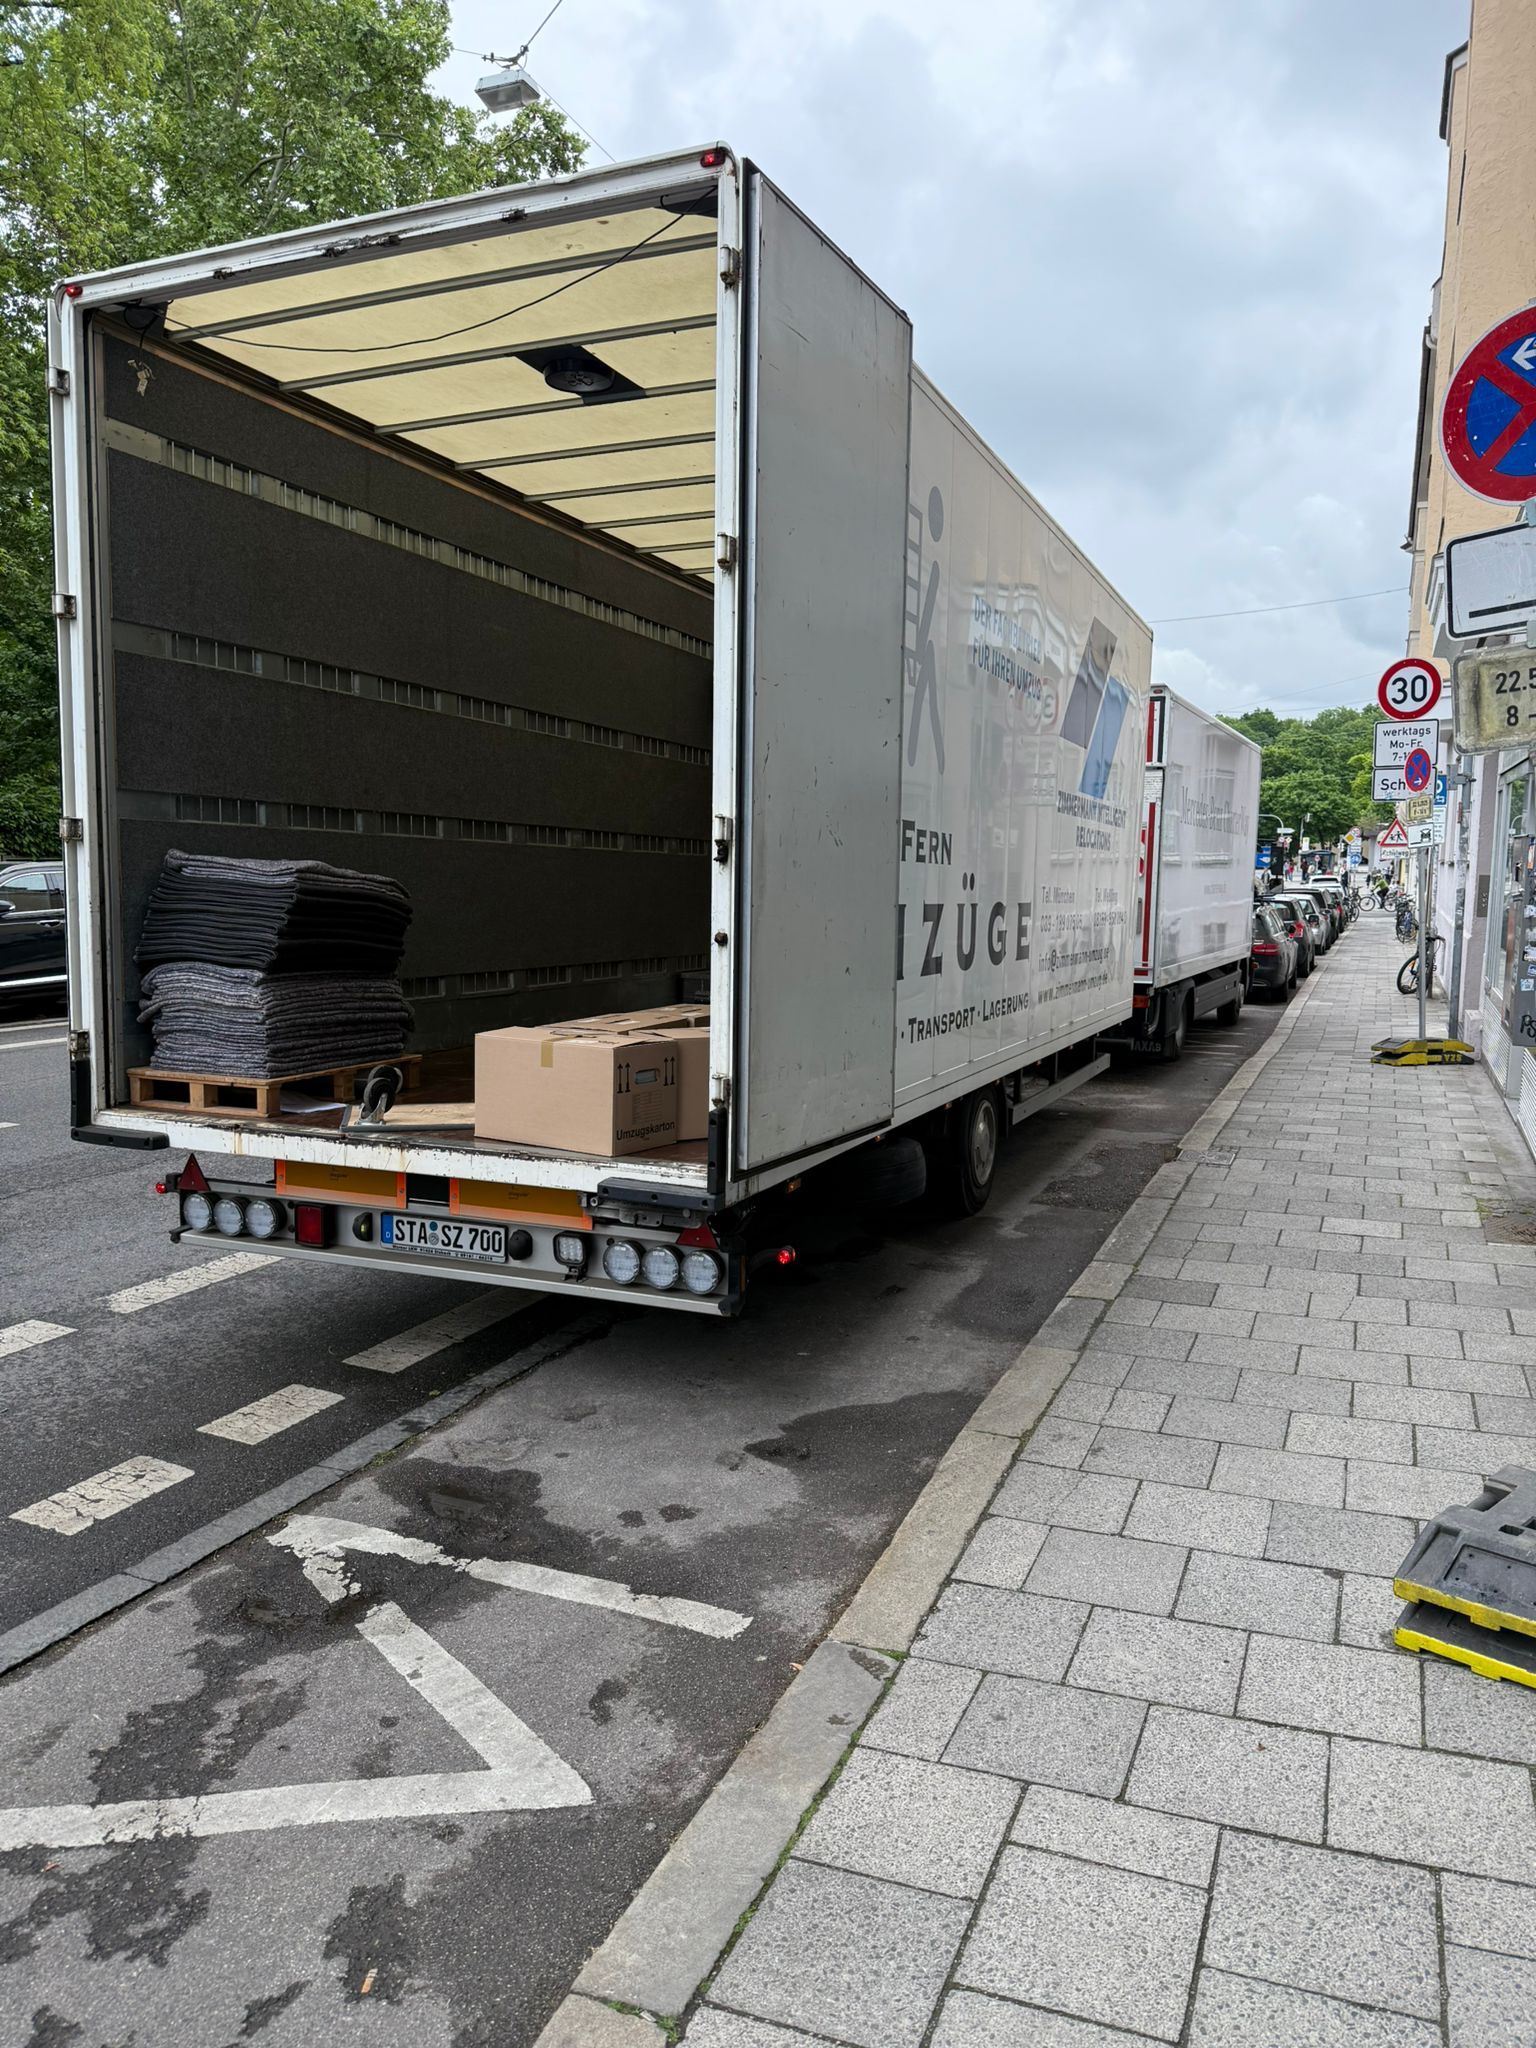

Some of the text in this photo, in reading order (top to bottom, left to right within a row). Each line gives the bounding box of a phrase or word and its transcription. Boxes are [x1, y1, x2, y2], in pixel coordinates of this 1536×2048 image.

[974, 594, 991, 631] DER
[972, 634, 1041, 700] FÜR IHREN UMZUG
[1391, 674, 1427, 704] 30
[1506, 704, 1519, 727] 8
[1382, 727, 1431, 737] werktags
[901, 819, 952, 866] FERN
[1075, 826, 1111, 852] RELOCATIONS
[907, 993, 1029, 1044] TRANSPORT LAGERUNG
[616, 1120, 676, 1141] Umzugskarton
[385, 1231, 391, 1239] D
[395, 1219, 428, 1245] STA
[441, 1225, 464, 1249] SZ
[469, 1227, 503, 1253] 700
